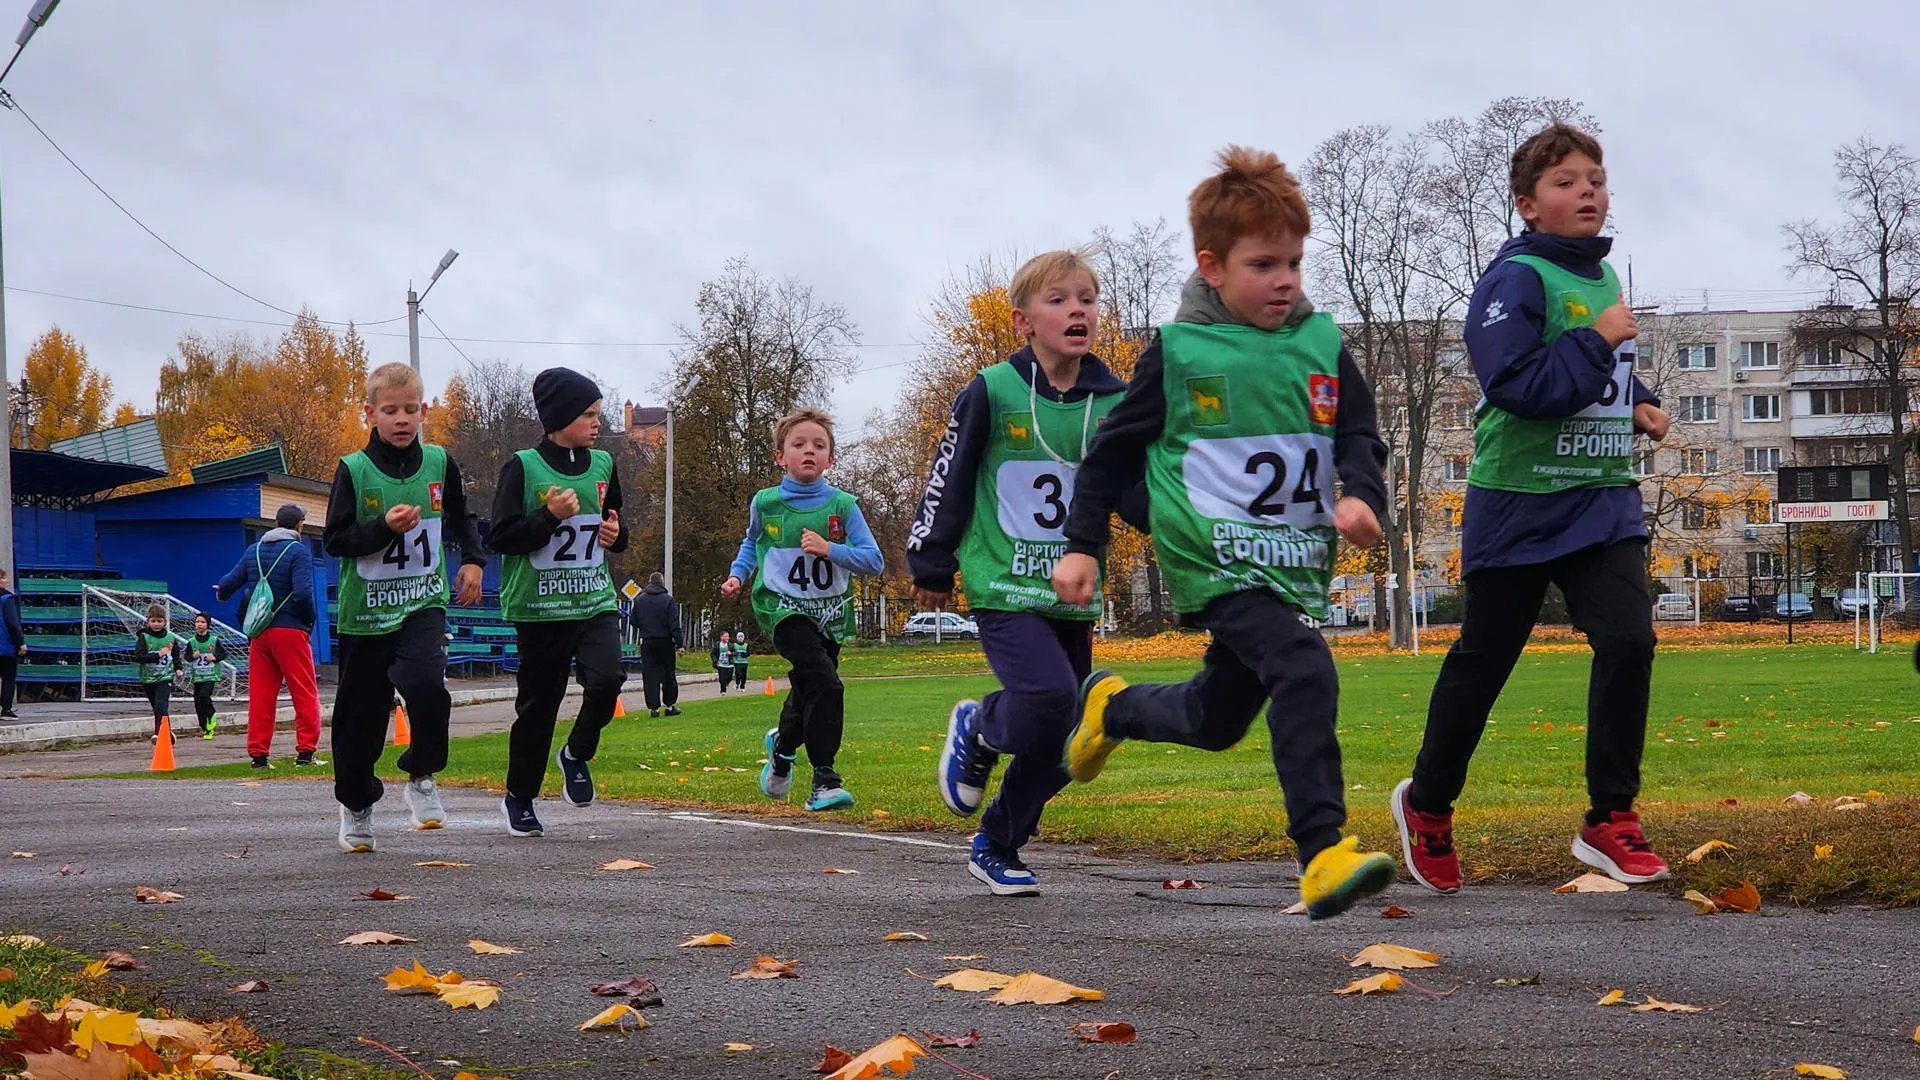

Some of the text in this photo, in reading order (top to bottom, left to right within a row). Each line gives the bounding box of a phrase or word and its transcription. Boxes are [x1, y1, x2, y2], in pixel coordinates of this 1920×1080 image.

[907, 412, 960, 552] APOCALYPSE
[1244, 448, 1325, 517] 24
[1781, 504, 1875, 519] БРОННИЦЫ ГОСТИ
[382, 529, 431, 570] 41
[553, 524, 600, 561] 27
[1015, 541, 1068, 558] СПОРТИВ
[788, 556, 833, 591] 40
